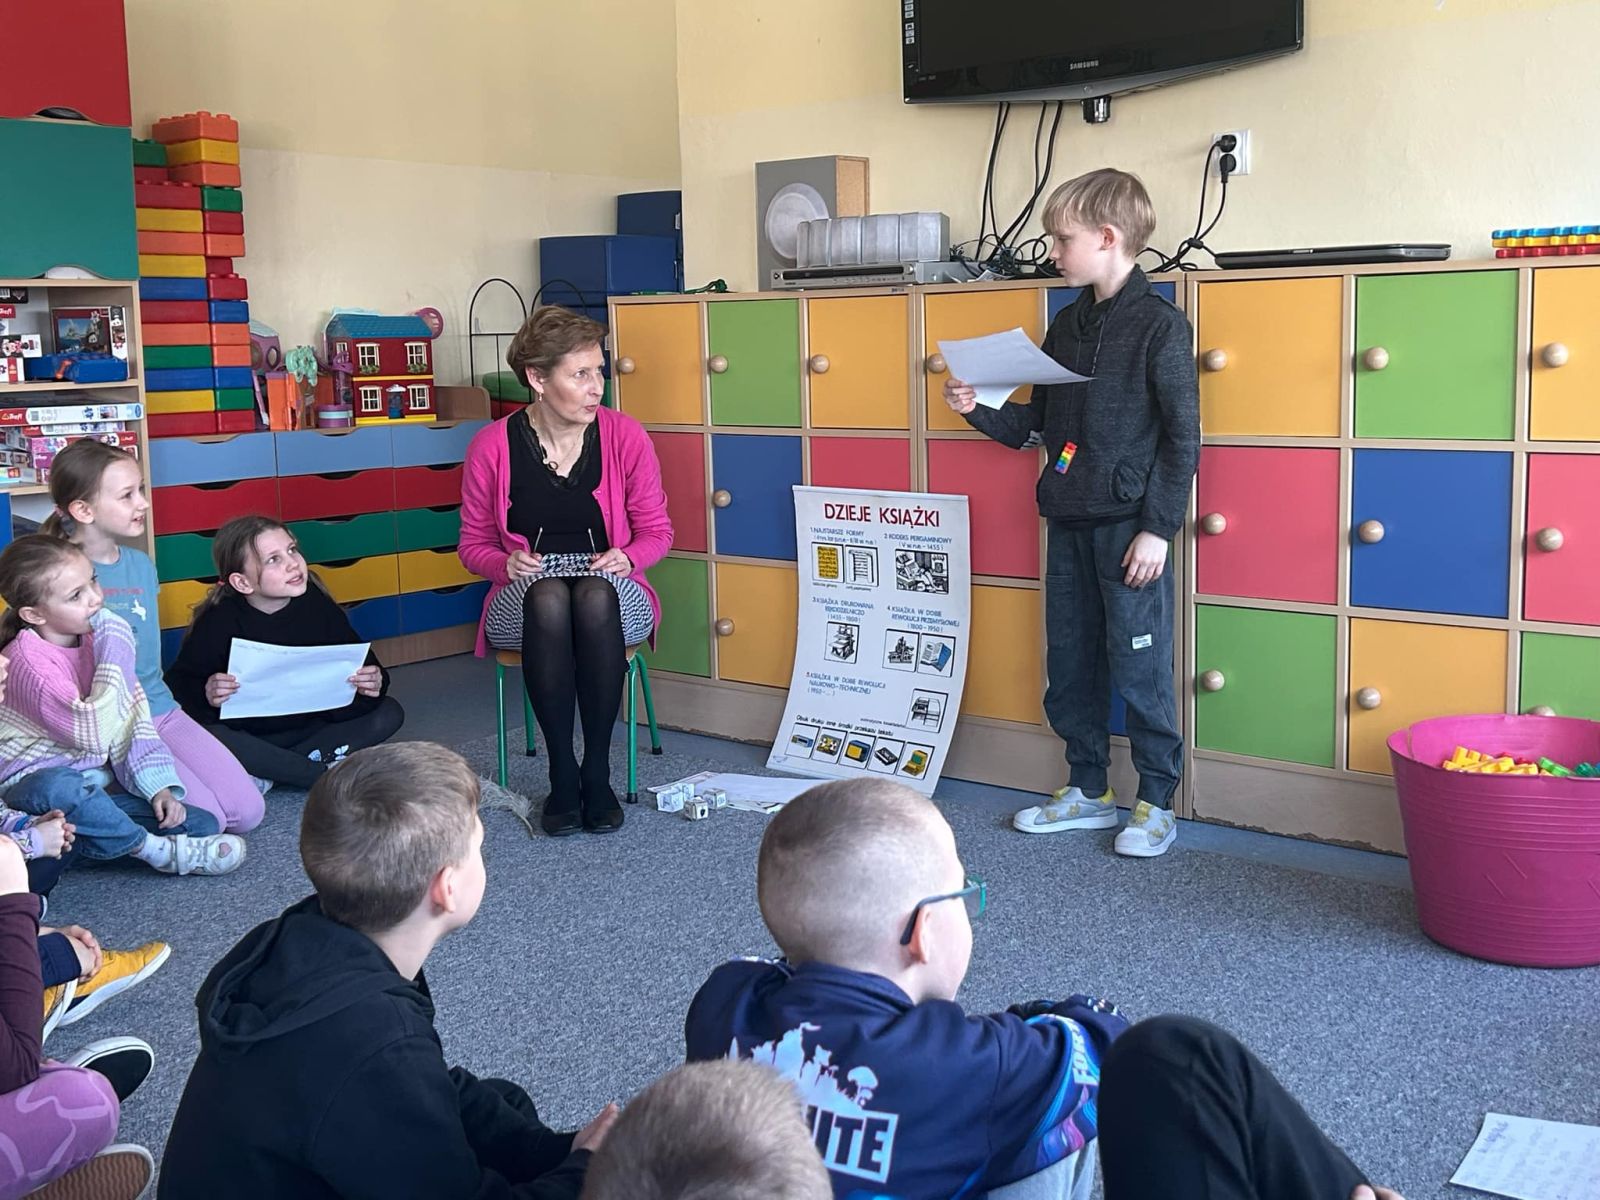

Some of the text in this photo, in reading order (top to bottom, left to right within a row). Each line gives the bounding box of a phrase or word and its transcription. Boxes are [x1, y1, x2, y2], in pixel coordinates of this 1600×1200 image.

[1070, 60, 1099, 70] SAMSUNG
[824, 503, 940, 529] DZIEJE KSIĄŻKI
